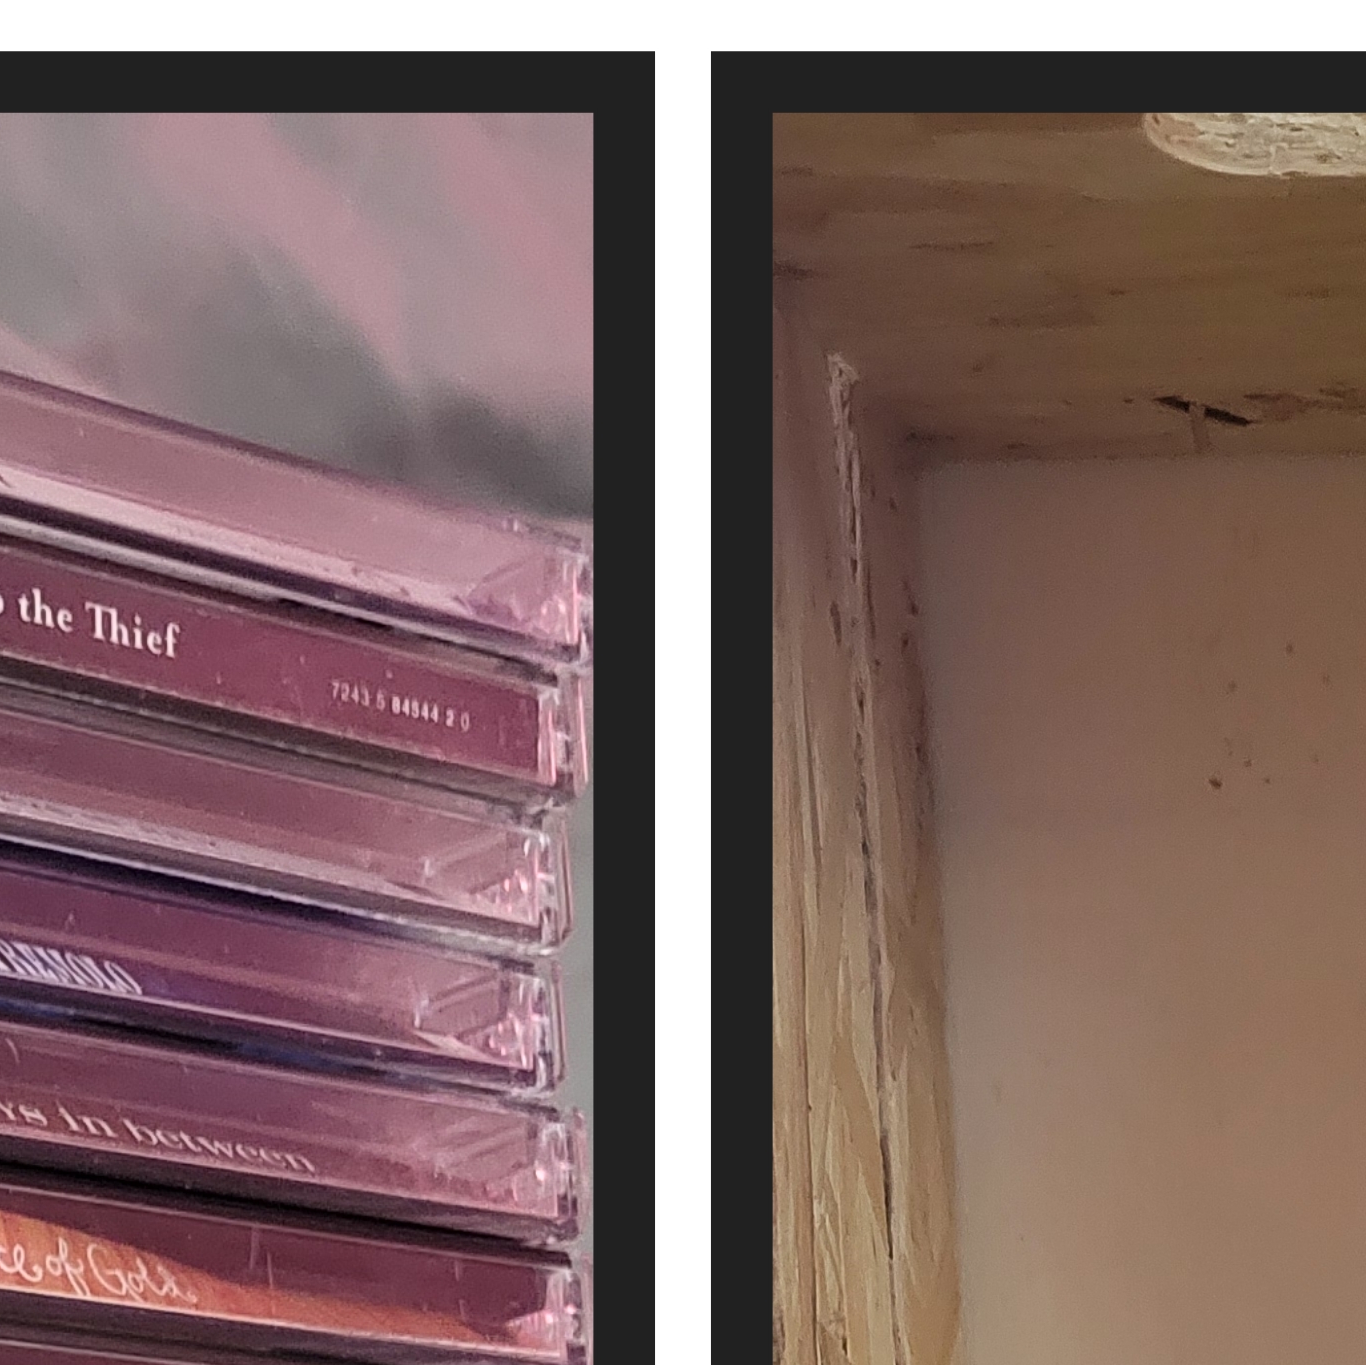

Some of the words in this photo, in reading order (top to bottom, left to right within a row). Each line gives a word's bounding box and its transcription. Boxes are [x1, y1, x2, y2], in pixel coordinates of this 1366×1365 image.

[19, 588, 73, 634] the
[85, 601, 181, 658] Thief
[123, 1117, 319, 1176] between
